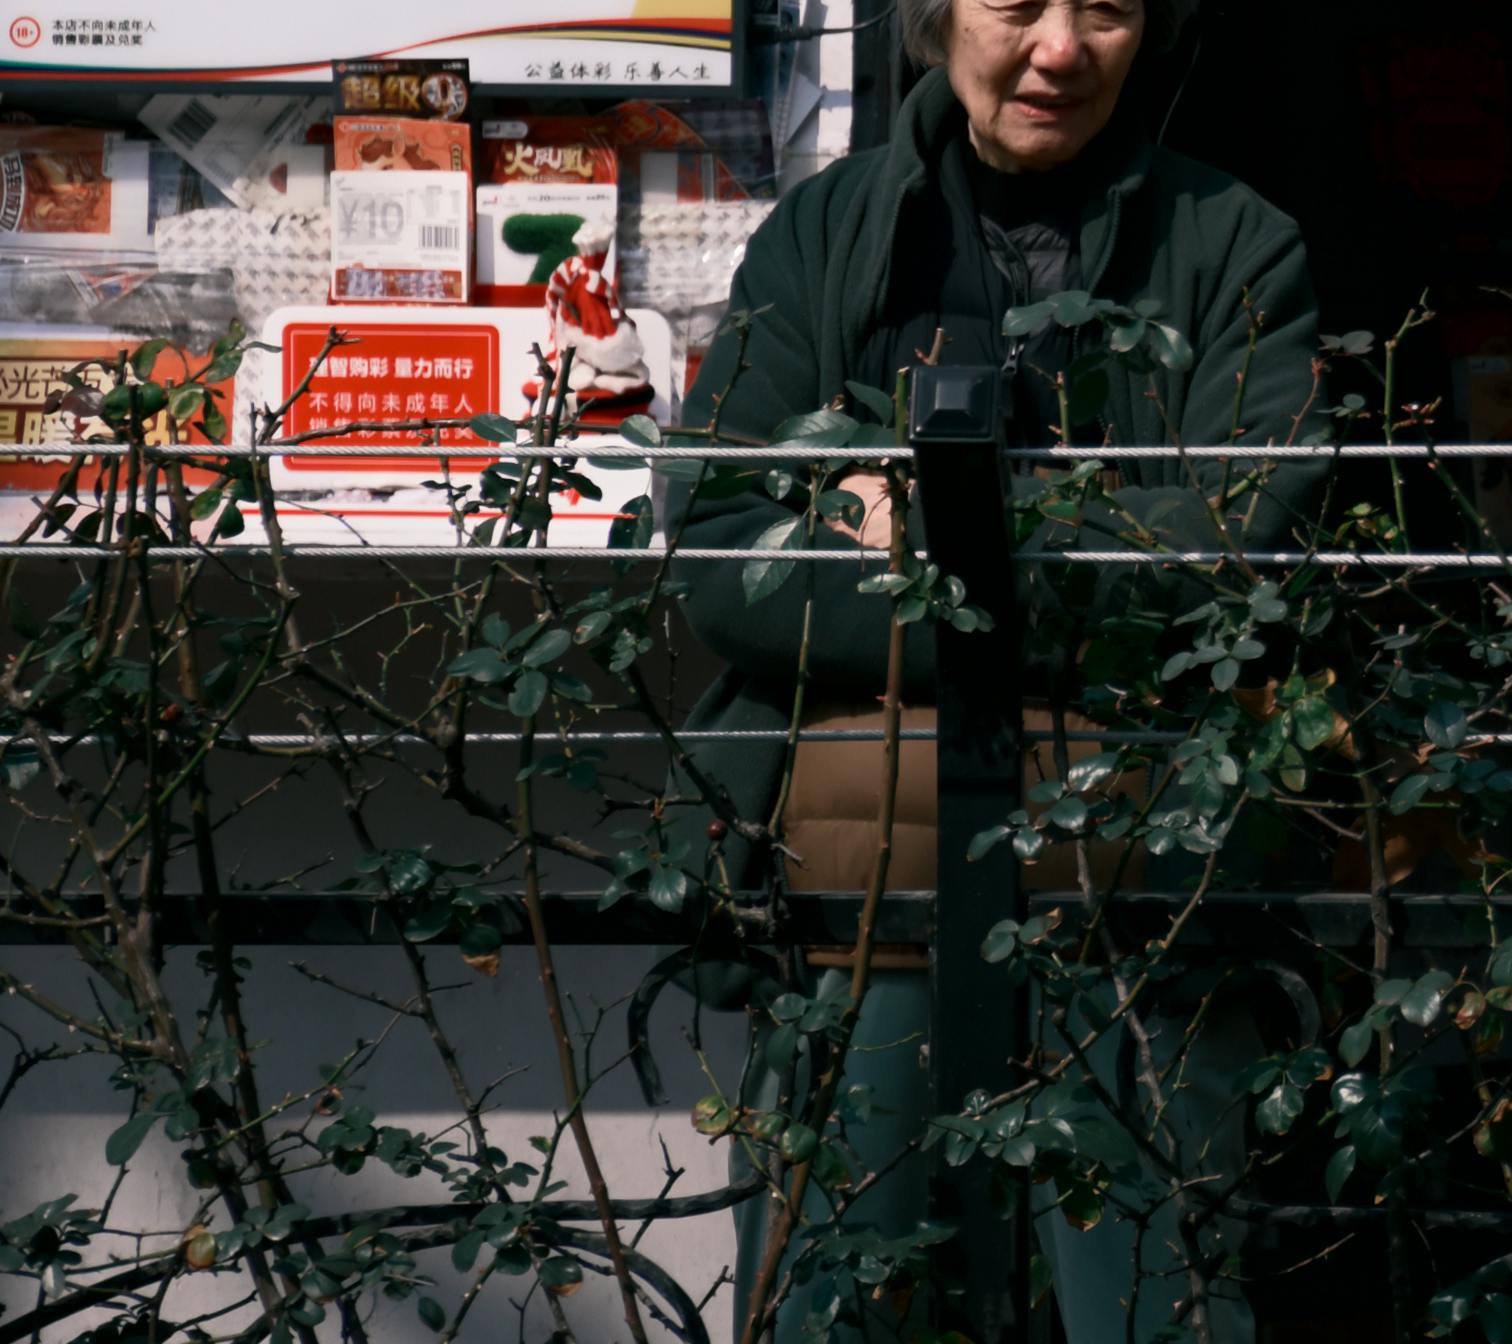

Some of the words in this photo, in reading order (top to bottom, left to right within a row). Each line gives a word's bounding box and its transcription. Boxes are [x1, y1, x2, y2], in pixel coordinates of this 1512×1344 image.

[525, 60, 612, 81] 公益体彩
[624, 60, 712, 81] 乐善人生
[309, 356, 390, 379] 理智购彩
[394, 356, 474, 379] 量力而行
[309, 392, 474, 414] 不得向未成年人
